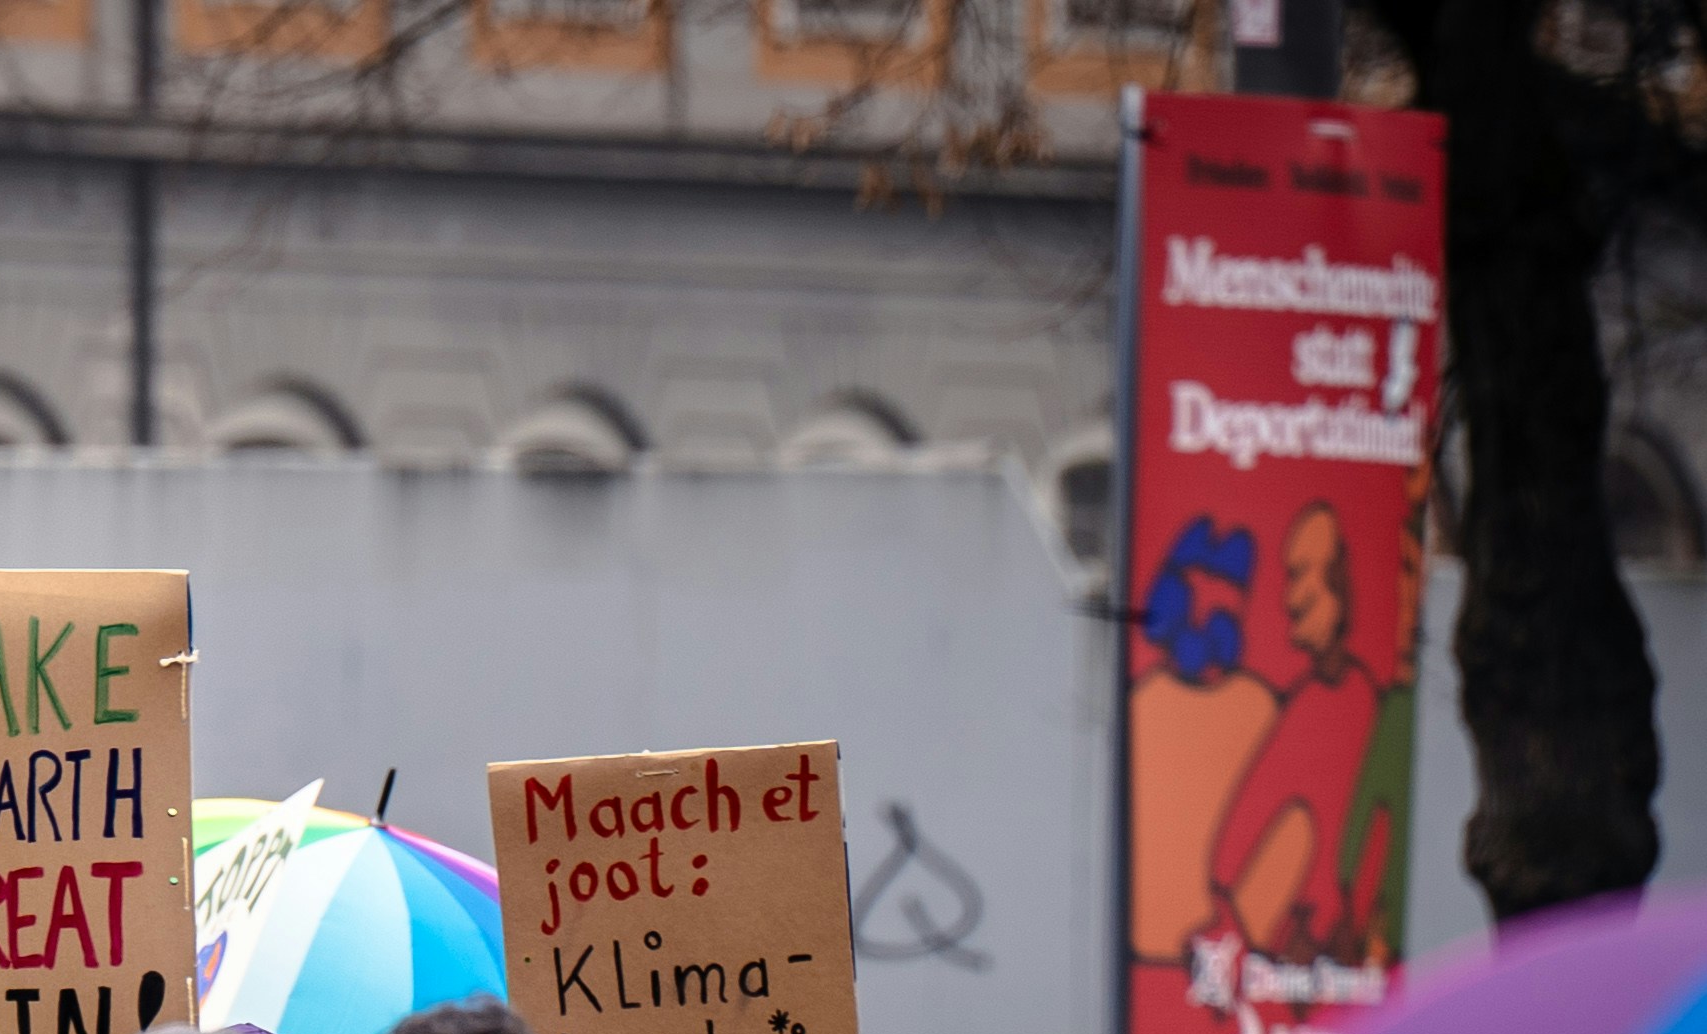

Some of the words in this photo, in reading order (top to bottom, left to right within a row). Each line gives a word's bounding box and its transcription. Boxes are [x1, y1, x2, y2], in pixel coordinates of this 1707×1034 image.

[524, 757, 742, 844] Maach
[762, 754, 821, 823] et
[541, 837, 710, 936] joot:
